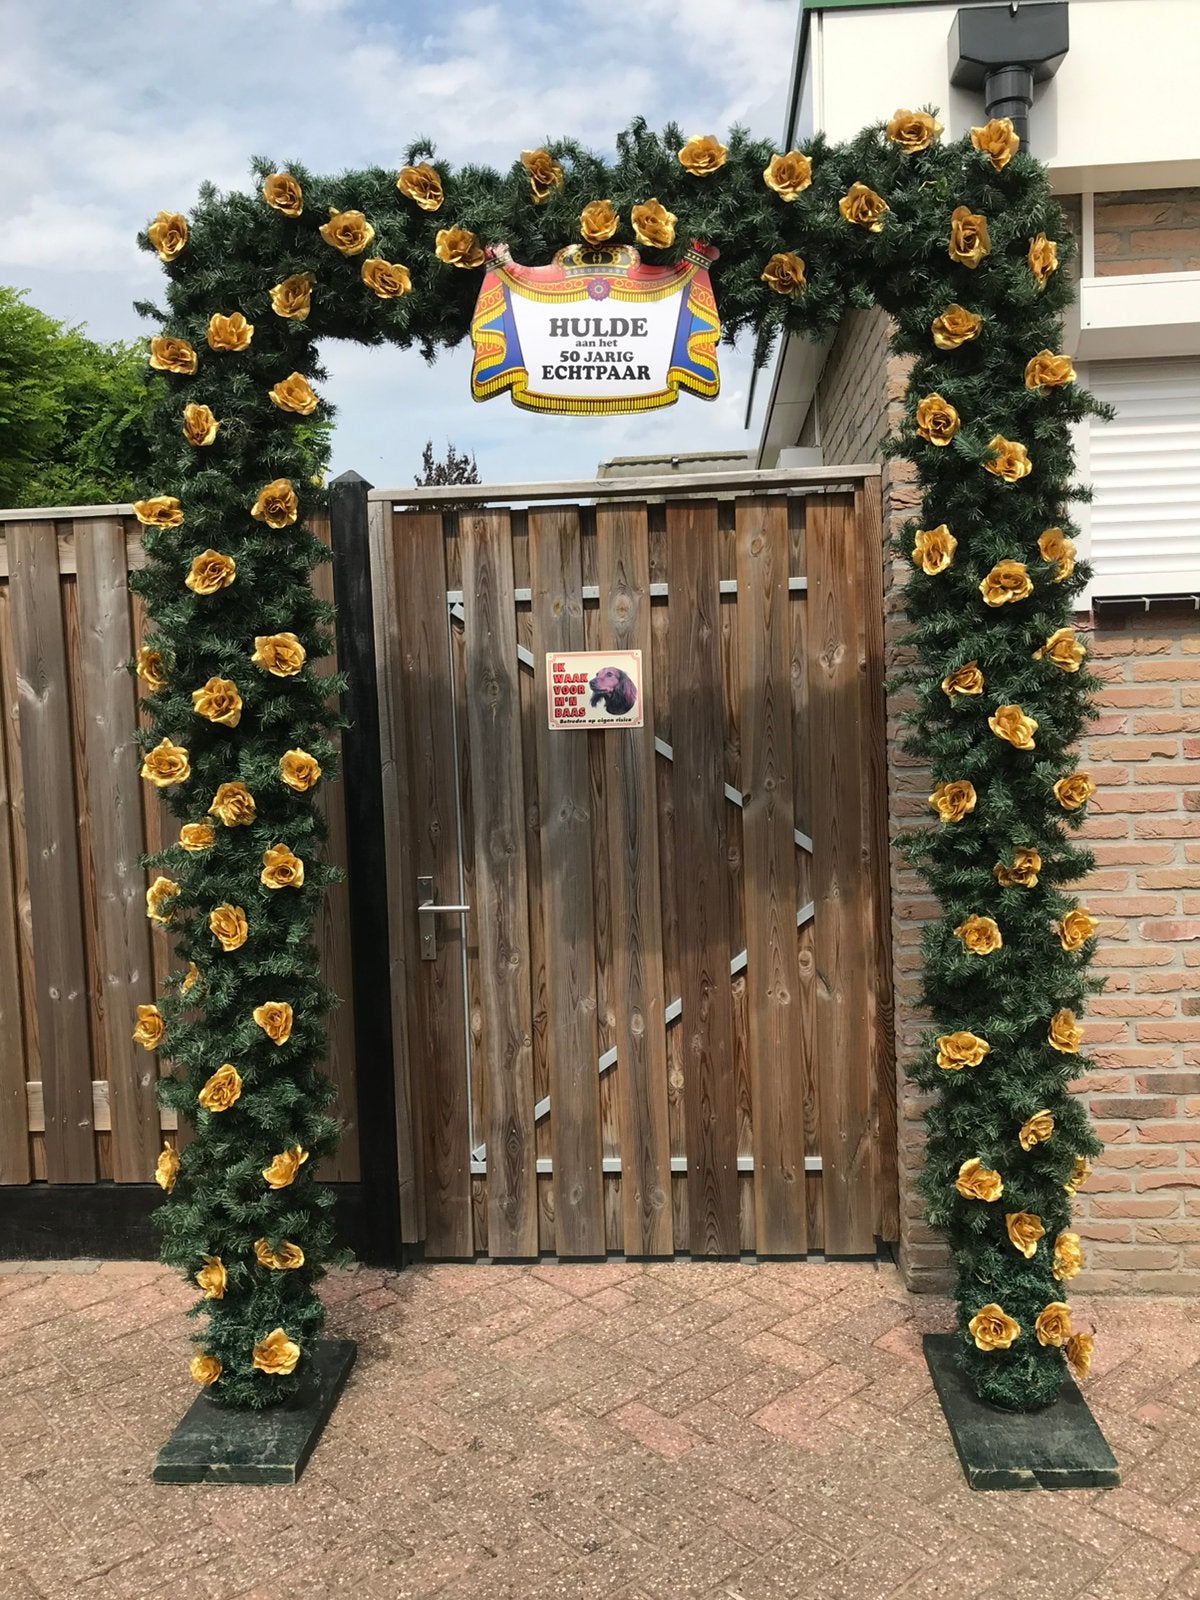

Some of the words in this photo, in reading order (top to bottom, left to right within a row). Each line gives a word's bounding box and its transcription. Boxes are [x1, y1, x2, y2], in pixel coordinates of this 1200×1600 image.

[549, 317, 648, 337] HULDE
[575, 339, 596, 347] aan
[599, 338, 618, 347] het
[560, 351, 581, 363] 50
[583, 351, 634, 363] JARIG
[541, 365, 651, 380] ECHTPAAR
[552, 663, 566, 672] IK
[553, 673, 588, 684] WAAK
[553, 685, 585, 695] VOOR
[554, 696, 577, 707] M'N
[554, 707, 586, 718] BAAS
